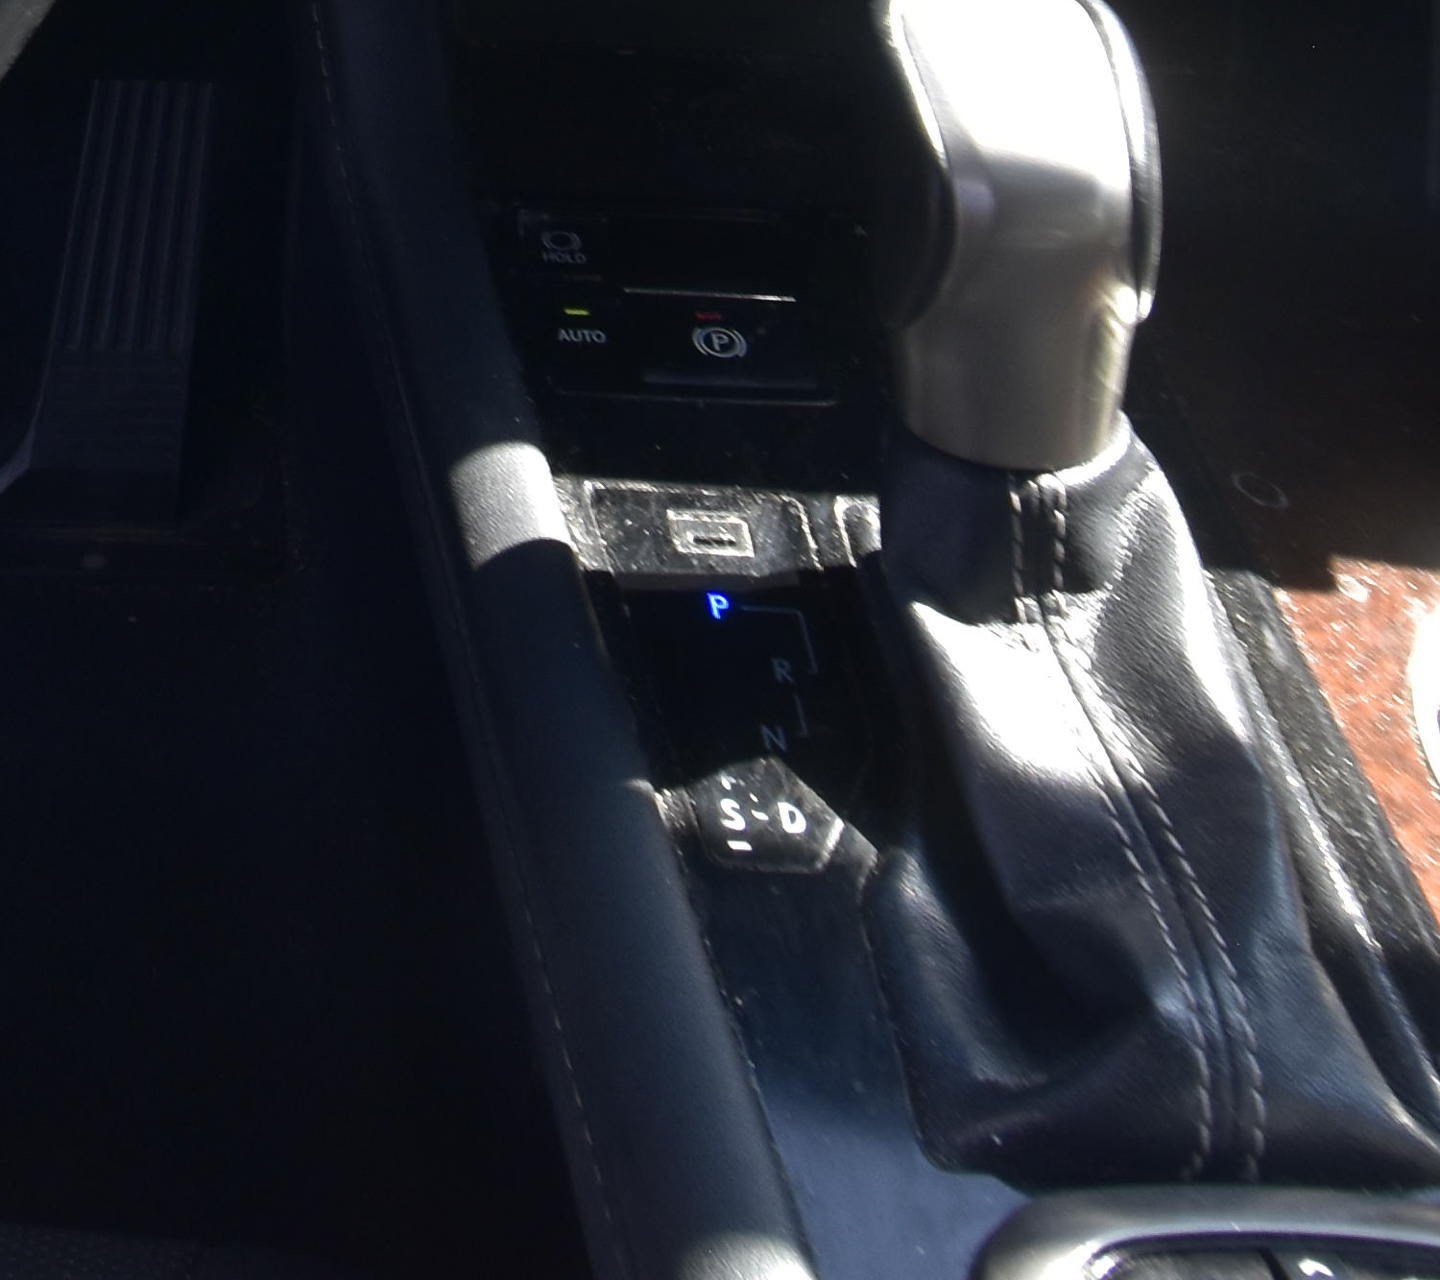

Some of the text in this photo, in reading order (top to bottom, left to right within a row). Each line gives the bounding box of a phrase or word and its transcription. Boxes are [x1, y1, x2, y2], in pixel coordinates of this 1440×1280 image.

[557, 327, 607, 345] AUTO
[706, 591, 730, 621] P
[772, 658, 794, 684] R
[760, 725, 788, 753] N
